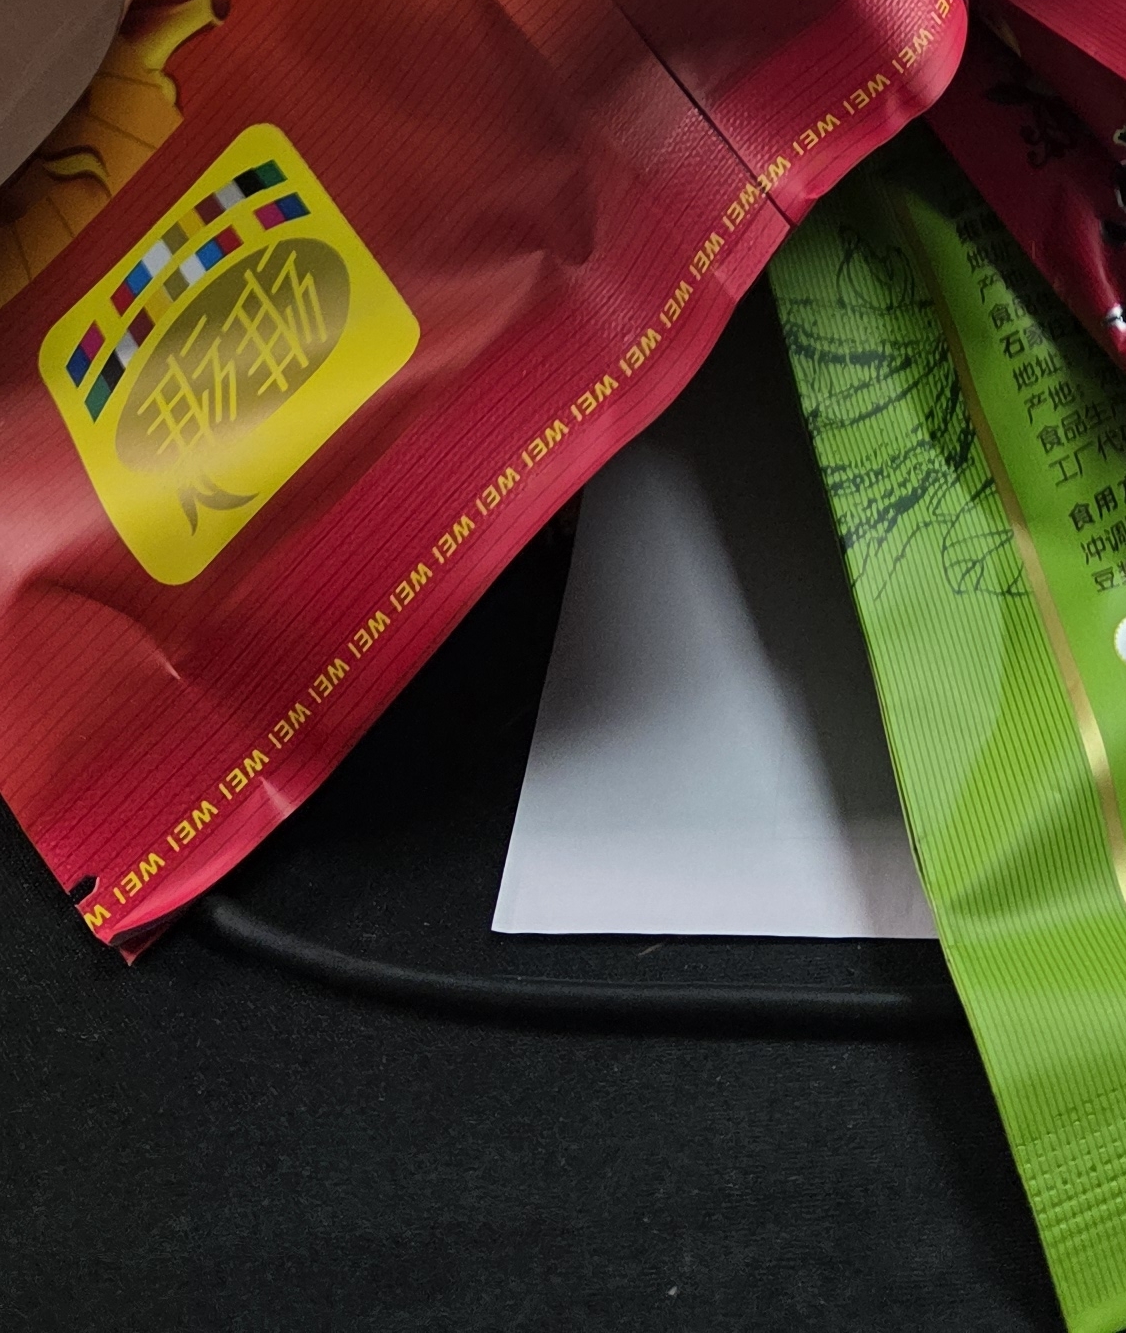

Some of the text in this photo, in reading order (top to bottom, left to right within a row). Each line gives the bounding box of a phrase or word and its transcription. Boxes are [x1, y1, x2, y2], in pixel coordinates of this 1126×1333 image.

[891, 27, 934, 75] WEI
[843, 73, 891, 116] WEI
[793, 112, 841, 156] WEI
[689, 231, 725, 282] WEI
[659, 280, 694, 329] WEI
[619, 328, 662, 378] WEI
[571, 374, 619, 422] WEI
[522, 419, 570, 467] WEI
[476, 467, 520, 517] WEI
[432, 515, 476, 564] WEI
[389, 563, 434, 613] WEI
[348, 610, 392, 660] WEI
[308, 658, 351, 704] WEI
[267, 702, 311, 749] WEI
[218, 749, 270, 800] WEI
[166, 800, 219, 852] WEI
[112, 852, 166, 906] WEI
